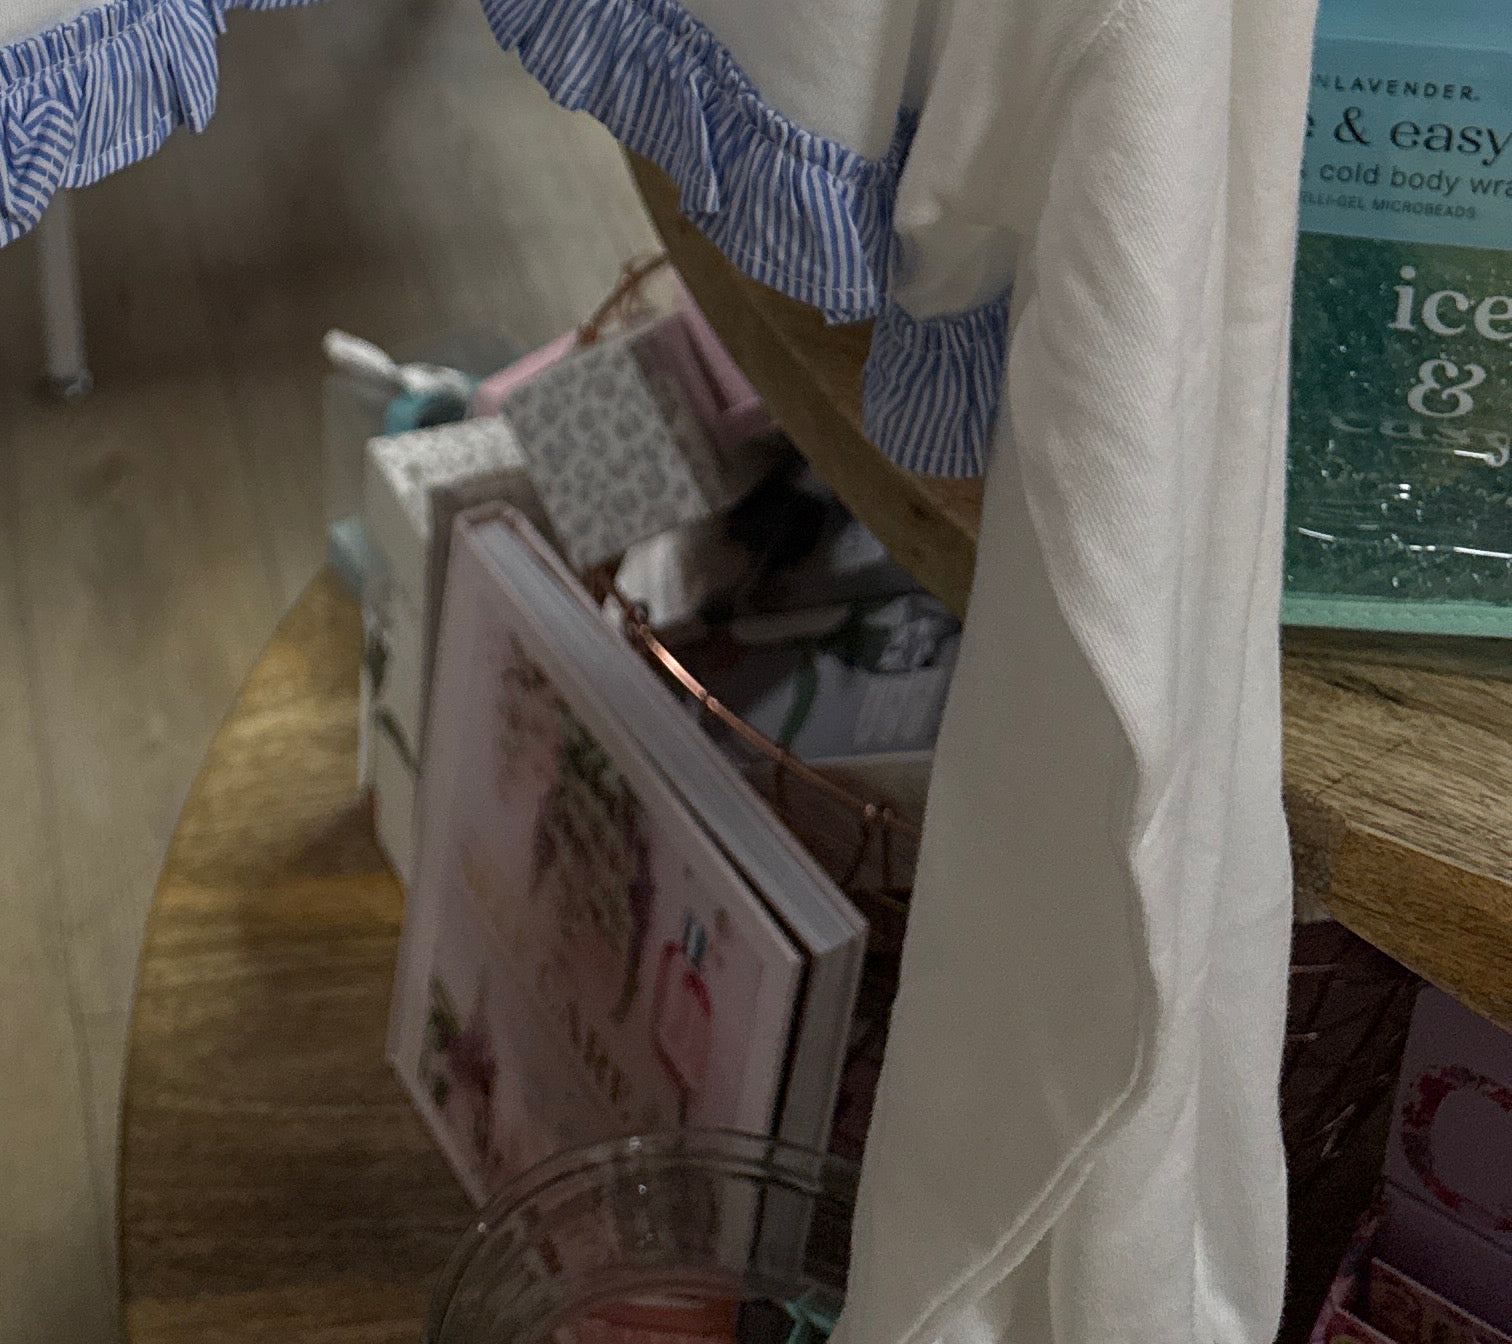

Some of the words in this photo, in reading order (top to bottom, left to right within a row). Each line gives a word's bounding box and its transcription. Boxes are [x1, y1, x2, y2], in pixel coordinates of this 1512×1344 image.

[1334, 106, 1371, 145] &
[1390, 120, 1512, 166] easy
[1320, 163, 1380, 189] cold
[1391, 165, 1463, 197] body
[1388, 265, 1512, 341] ice
[1407, 358, 1487, 417] &
